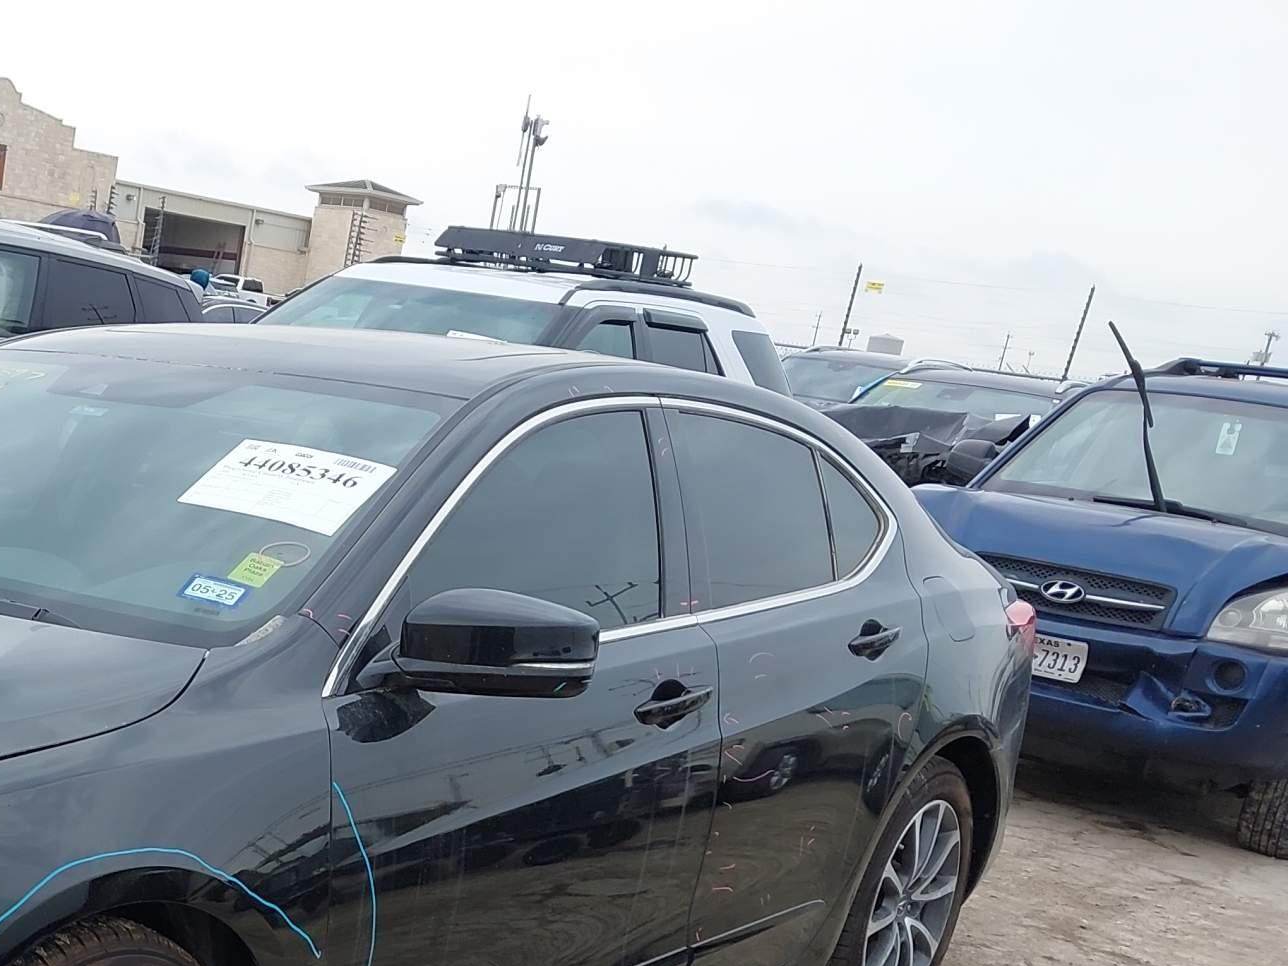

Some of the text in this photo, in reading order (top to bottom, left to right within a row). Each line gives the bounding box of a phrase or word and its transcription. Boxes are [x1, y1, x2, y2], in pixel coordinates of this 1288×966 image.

[239, 456, 361, 489] 44085346
[191, 583, 238, 601] 05 25
[1038, 648, 1081, 674] 7313
